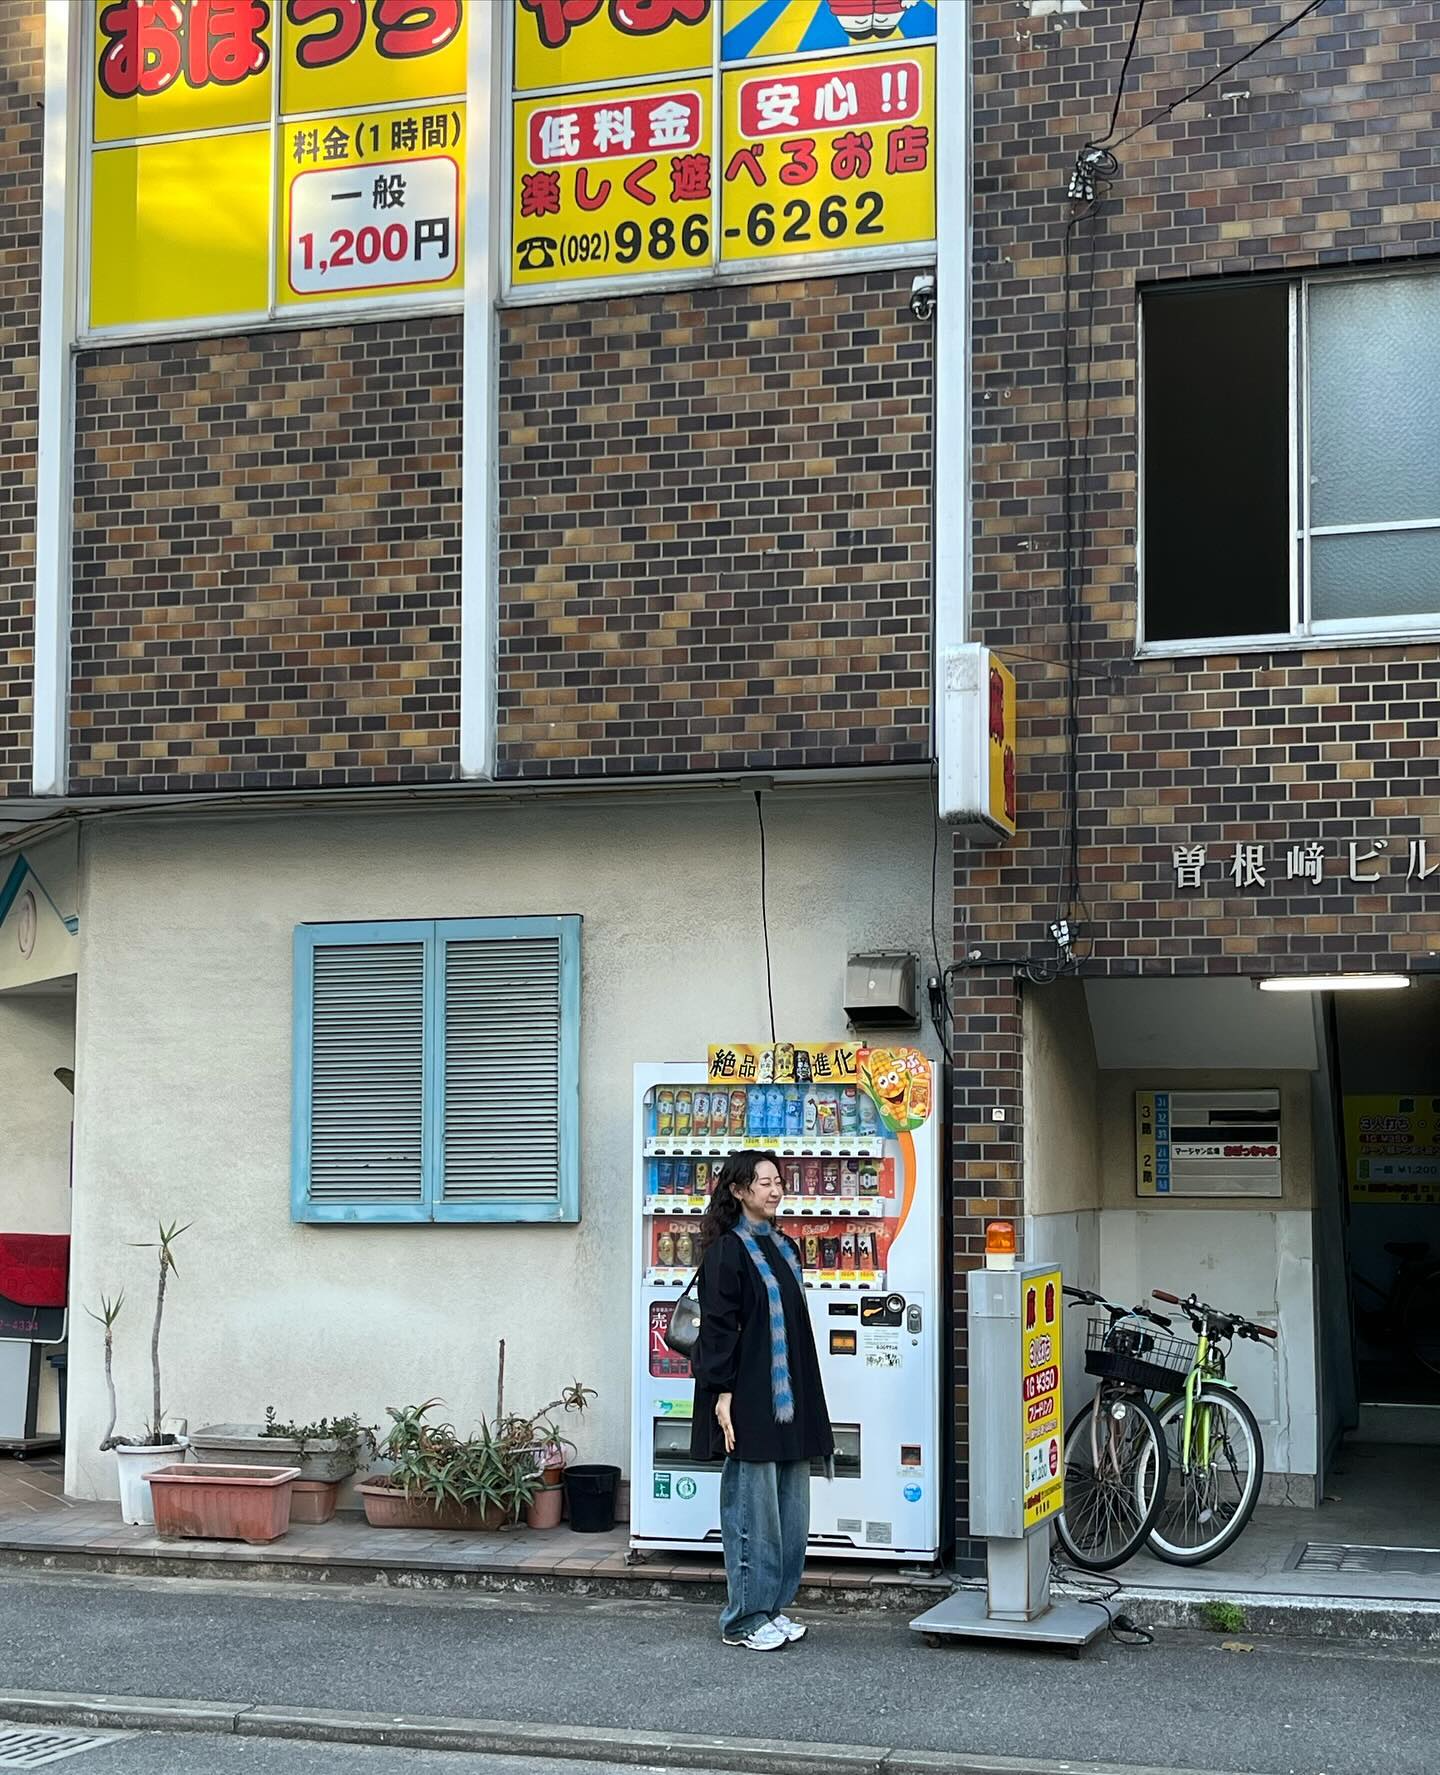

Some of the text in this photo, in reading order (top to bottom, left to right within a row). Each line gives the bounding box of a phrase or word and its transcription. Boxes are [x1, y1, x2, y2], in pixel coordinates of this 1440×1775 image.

[539, 101, 692, 159] 低料金
[331, 173, 406, 209] 一般
[298, 217, 450, 275] 1,200円
[710, 1049, 857, 1078] 絶品 進化
